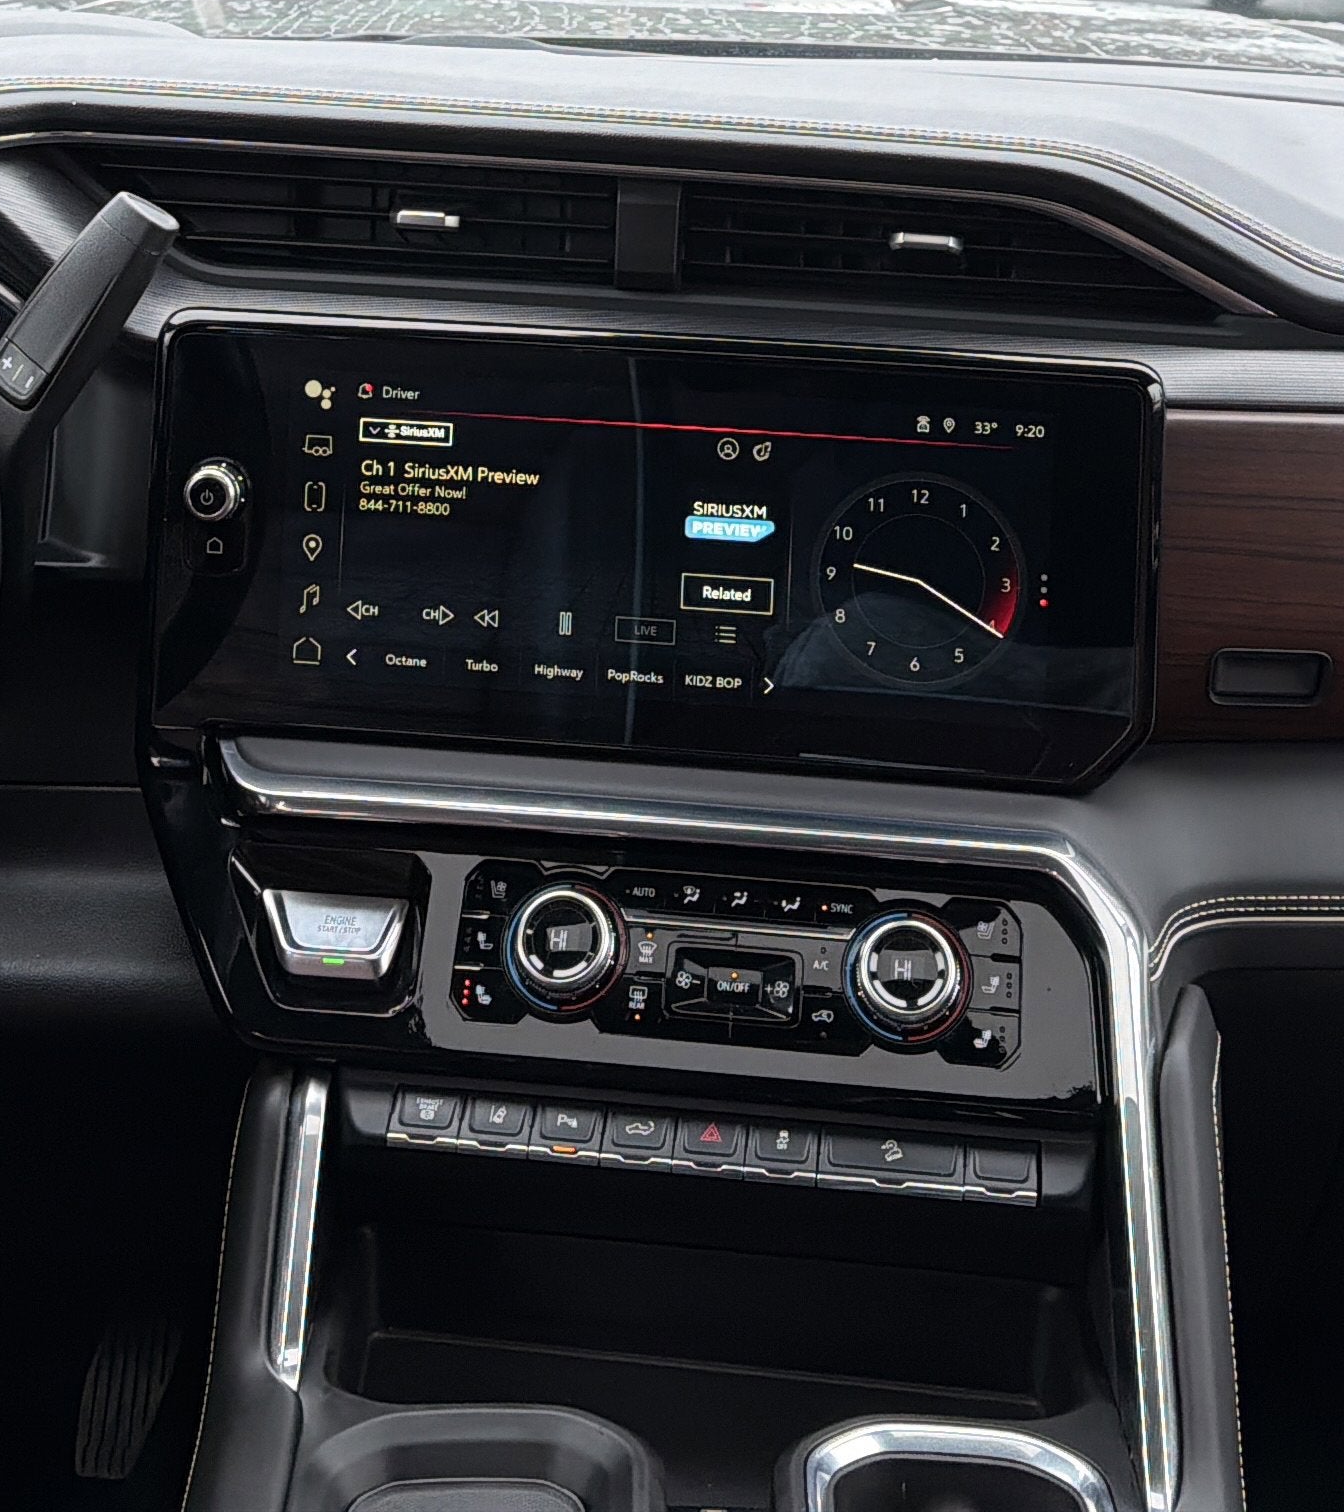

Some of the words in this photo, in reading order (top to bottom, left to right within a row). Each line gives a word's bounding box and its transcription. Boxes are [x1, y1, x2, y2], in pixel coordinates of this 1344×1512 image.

[382, 386, 420, 400] Driver
[399, 425, 445, 439] SiriusXM
[974, 421, 998, 435] 33°
[1015, 424, 1045, 438] 9:20
[361, 459, 382, 476] Ch
[387, 462, 395, 476] 1
[404, 463, 473, 482] SiriusXM
[477, 467, 540, 485] Preview
[360, 481, 395, 495] Great
[398, 483, 432, 497] Offer
[435, 486, 467, 500] Now!
[911, 489, 929, 504] 12
[359, 498, 451, 515] 844-711-8800
[693, 501, 767, 519] SIRIUSXM
[868, 498, 885, 512] 11
[959, 504, 967, 518] 1
[692, 520, 767, 537] PREVIEW
[834, 525, 853, 541] 10
[990, 537, 1001, 551] 2
[826, 566, 837, 580] 9
[1000, 578, 1011, 592] 3
[702, 586, 752, 602] Related
[362, 604, 379, 616] CH
[422, 608, 439, 621] CH
[835, 608, 846, 623] 8
[634, 625, 657, 636] LIVE
[867, 642, 877, 656] 7
[954, 648, 964, 663] 5
[385, 654, 427, 667] Octane
[465, 659, 499, 672] Turbo
[909, 657, 920, 671] 6
[534, 664, 584, 681] Highway
[607, 668, 664, 684] PopRocks
[685, 674, 712, 688] KIDZ
[716, 676, 742, 689] BOP
[632, 887, 655, 898] AUTO
[830, 902, 854, 914] SYNC
[324, 915, 357, 926] ENGINE
[549, 929, 568, 951] HI
[813, 960, 829, 971] A/C
[894, 959, 912, 981] HI
[717, 982, 750, 994] ON/OFF
